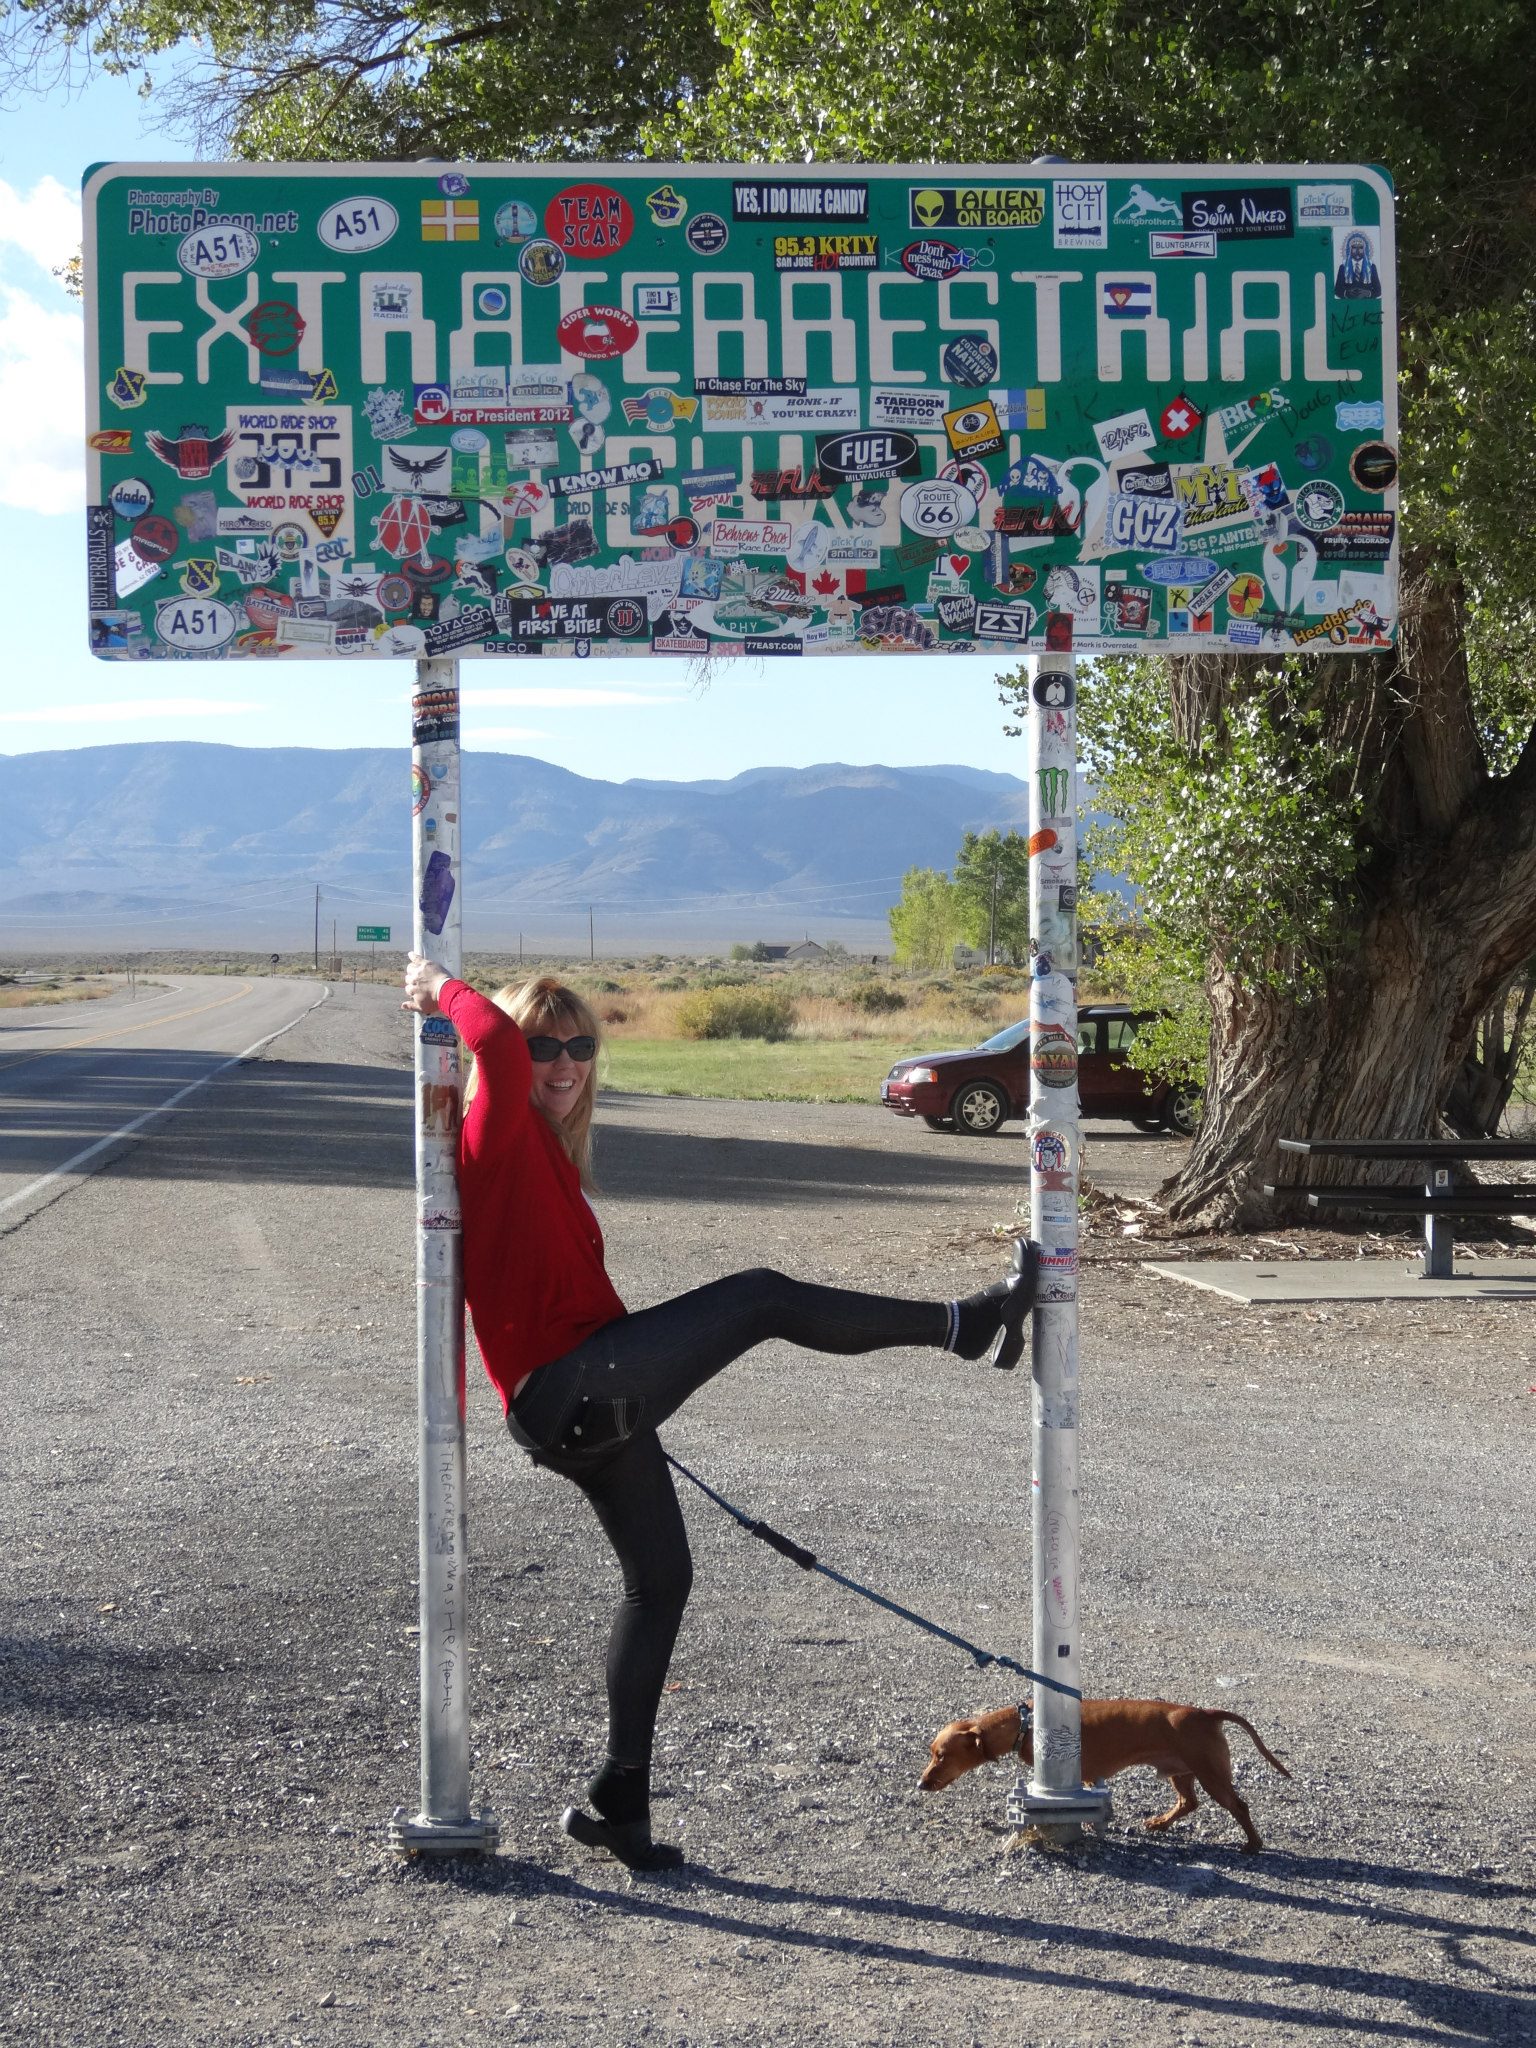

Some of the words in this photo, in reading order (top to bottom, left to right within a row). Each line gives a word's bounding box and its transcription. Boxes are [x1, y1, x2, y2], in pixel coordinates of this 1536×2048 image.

[128, 190, 200, 206] Photography
[203, 190, 219, 204] By
[735, 188, 761, 215] YES,
[763, 188, 768, 213] I
[771, 188, 788, 213] DO
[790, 188, 822, 214] HAVE
[824, 189, 867, 216] CANDY
[961, 190, 1038, 209] ALIEN
[1056, 184, 1104, 205] HOLY
[560, 197, 621, 222] TEAM
[957, 211, 982, 226] ON
[986, 209, 1042, 226] BOARD
[335, 206, 380, 240] A51
[563, 223, 621, 247] SCAR
[1058, 238, 1103, 247] BREWING
[195, 233, 243, 266] A51
[774, 236, 816, 256] 95.3
[818, 235, 878, 255] KRTY
[920, 240, 945, 256] Don't
[1155, 240, 1210, 249] BLUNTGRAFFIX
[776, 256, 792, 268] SAN
[793, 256, 813, 268] JOSE
[839, 255, 877, 267] COUNTRY!
[908, 252, 932, 264] mess
[932, 255, 952, 270] with
[561, 306, 591, 330] CIDER
[594, 306, 635, 328] WORKS
[122, 271, 1363, 385] EXTRATERRESTRIAL
[610, 349, 621, 357] WA
[961, 338, 994, 374] COLORADO
[952, 344, 989, 384] NATIVE
[695, 378, 705, 389] In
[708, 378, 741, 390] Chase
[744, 378, 761, 390] For
[763, 378, 783, 390] The
[785, 378, 805, 393] Sky
[787, 398, 821, 406] HONK
[829, 398, 842, 406] IF
[875, 396, 945, 409] STARBORN
[452, 410, 473, 423] For
[476, 408, 536, 423] President
[539, 408, 570, 422] 2012
[772, 409, 814, 418] YOU'RE
[815, 409, 857, 418] CRAZY!
[884, 406, 935, 417] TATTOO
[239, 414, 278, 429] WORLD
[280, 415, 306, 429] RIDE
[308, 415, 337, 429] SHOP
[841, 438, 898, 466] FUEL
[959, 439, 999, 458] LOOK!
[856, 462, 879, 470] CAFE
[352, 466, 386, 498] 01
[549, 479, 556, 493] I
[559, 468, 617, 491] KNOW
[622, 463, 651, 481] MO
[845, 470, 898, 482] MILWAUKEE
[115, 487, 147, 505] dada
[247, 495, 286, 509] WORLD
[289, 495, 313, 508] RIDE
[316, 495, 345, 508] SHOP
[692, 494, 732, 512] Sarah
[924, 493, 951, 502] ROUTE
[317, 516, 336, 526] 95.3
[920, 506, 954, 523] 66
[1112, 499, 1178, 546] GCZ
[1300, 514, 1338, 529] HAWAII
[716, 523, 760, 542] Behrens
[762, 525, 789, 544] Bros
[1324, 537, 1351, 545] FRUITA,
[738, 542, 762, 552] Race
[763, 543, 787, 553] Cars
[89, 529, 108, 608] BUTTERBALLS
[218, 551, 258, 570] BLANK
[240, 570, 258, 582] TV
[1152, 563, 1181, 579] FLY
[1185, 562, 1209, 578] ME
[1192, 589, 1213, 610] VEGAS
[1211, 572, 1230, 593] CREW
[571, 604, 588, 618] AT
[609, 602, 624, 618] JIMMY
[617, 609, 634, 626] JJ
[171, 609, 217, 634] A51
[518, 620, 558, 635] FIRST
[563, 619, 601, 635] BITE!
[1230, 623, 1261, 632] UNITED
[1293, 599, 1372, 647] HeadBlade
[656, 638, 706, 650] SKATEBOARDS
[746, 642, 801, 651] 77EAST.COM
